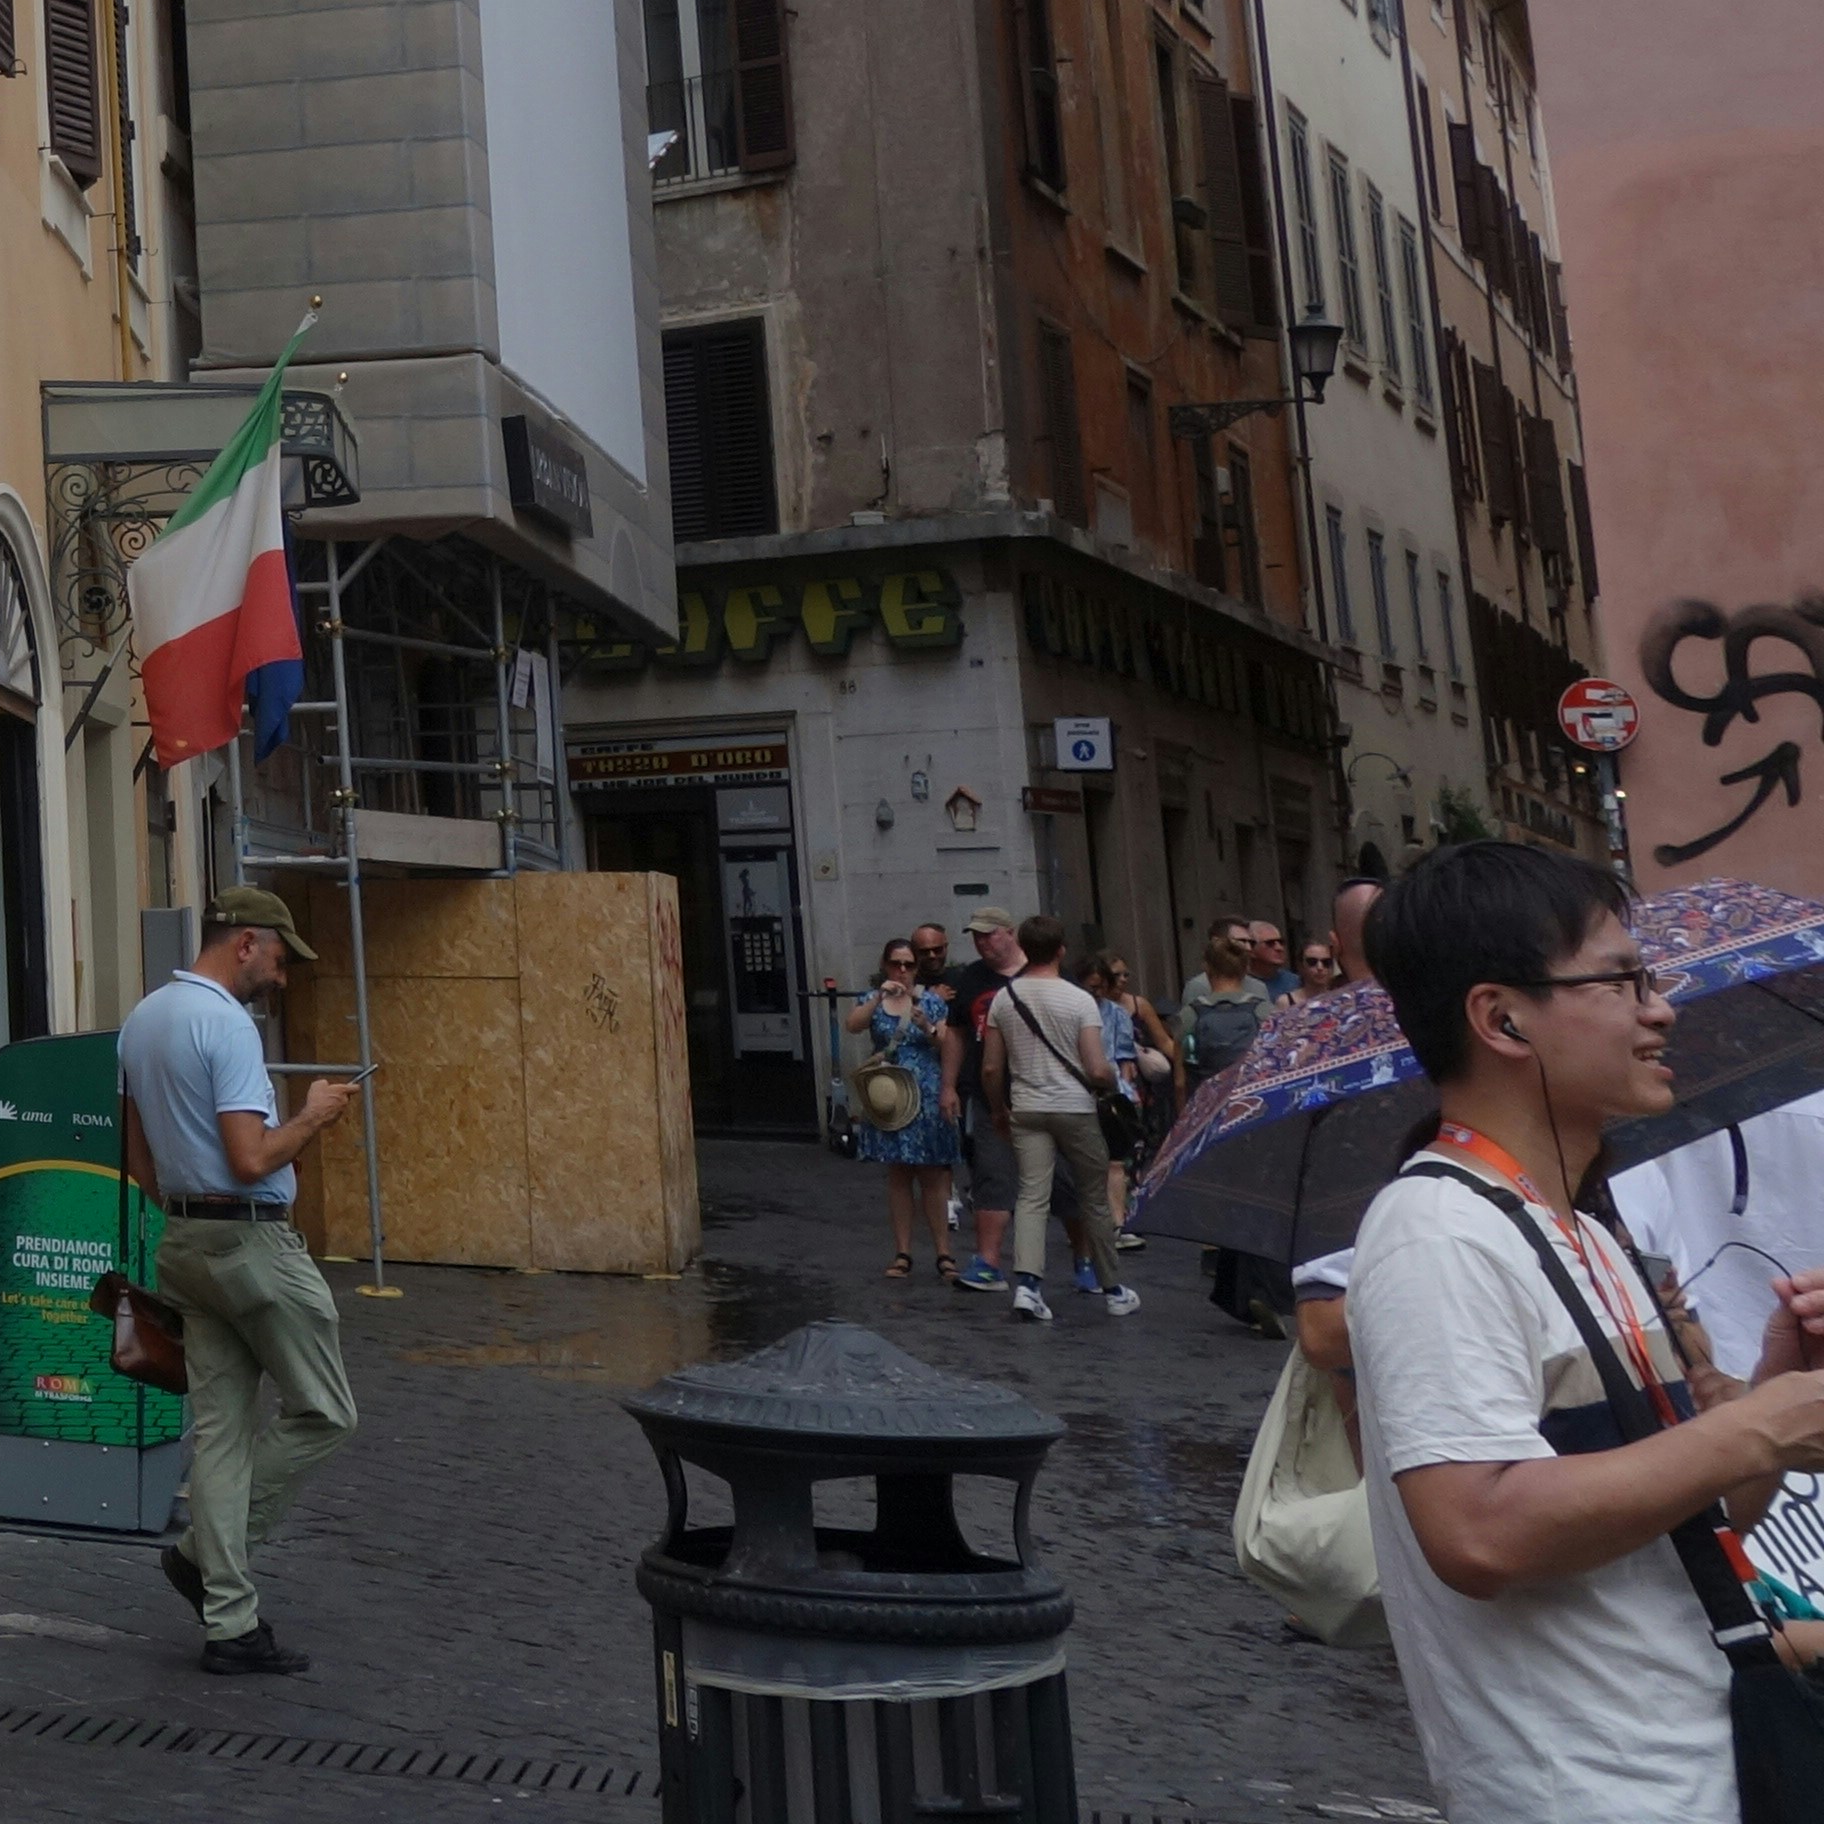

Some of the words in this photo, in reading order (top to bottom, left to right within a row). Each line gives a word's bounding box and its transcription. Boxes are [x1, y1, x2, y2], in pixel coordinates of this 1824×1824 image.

[21, 1108, 53, 1124] ama
[72, 1112, 114, 1128] ROMA
[15, 1234, 112, 1258] PRENDIAMOCI
[12, 1251, 50, 1270] CURA
[52, 1254, 69, 1271] DI
[71, 1255, 114, 1275] ROMA
[35, 1271, 95, 1291] INSIEME.
[36, 1376, 91, 1394] ROMA
